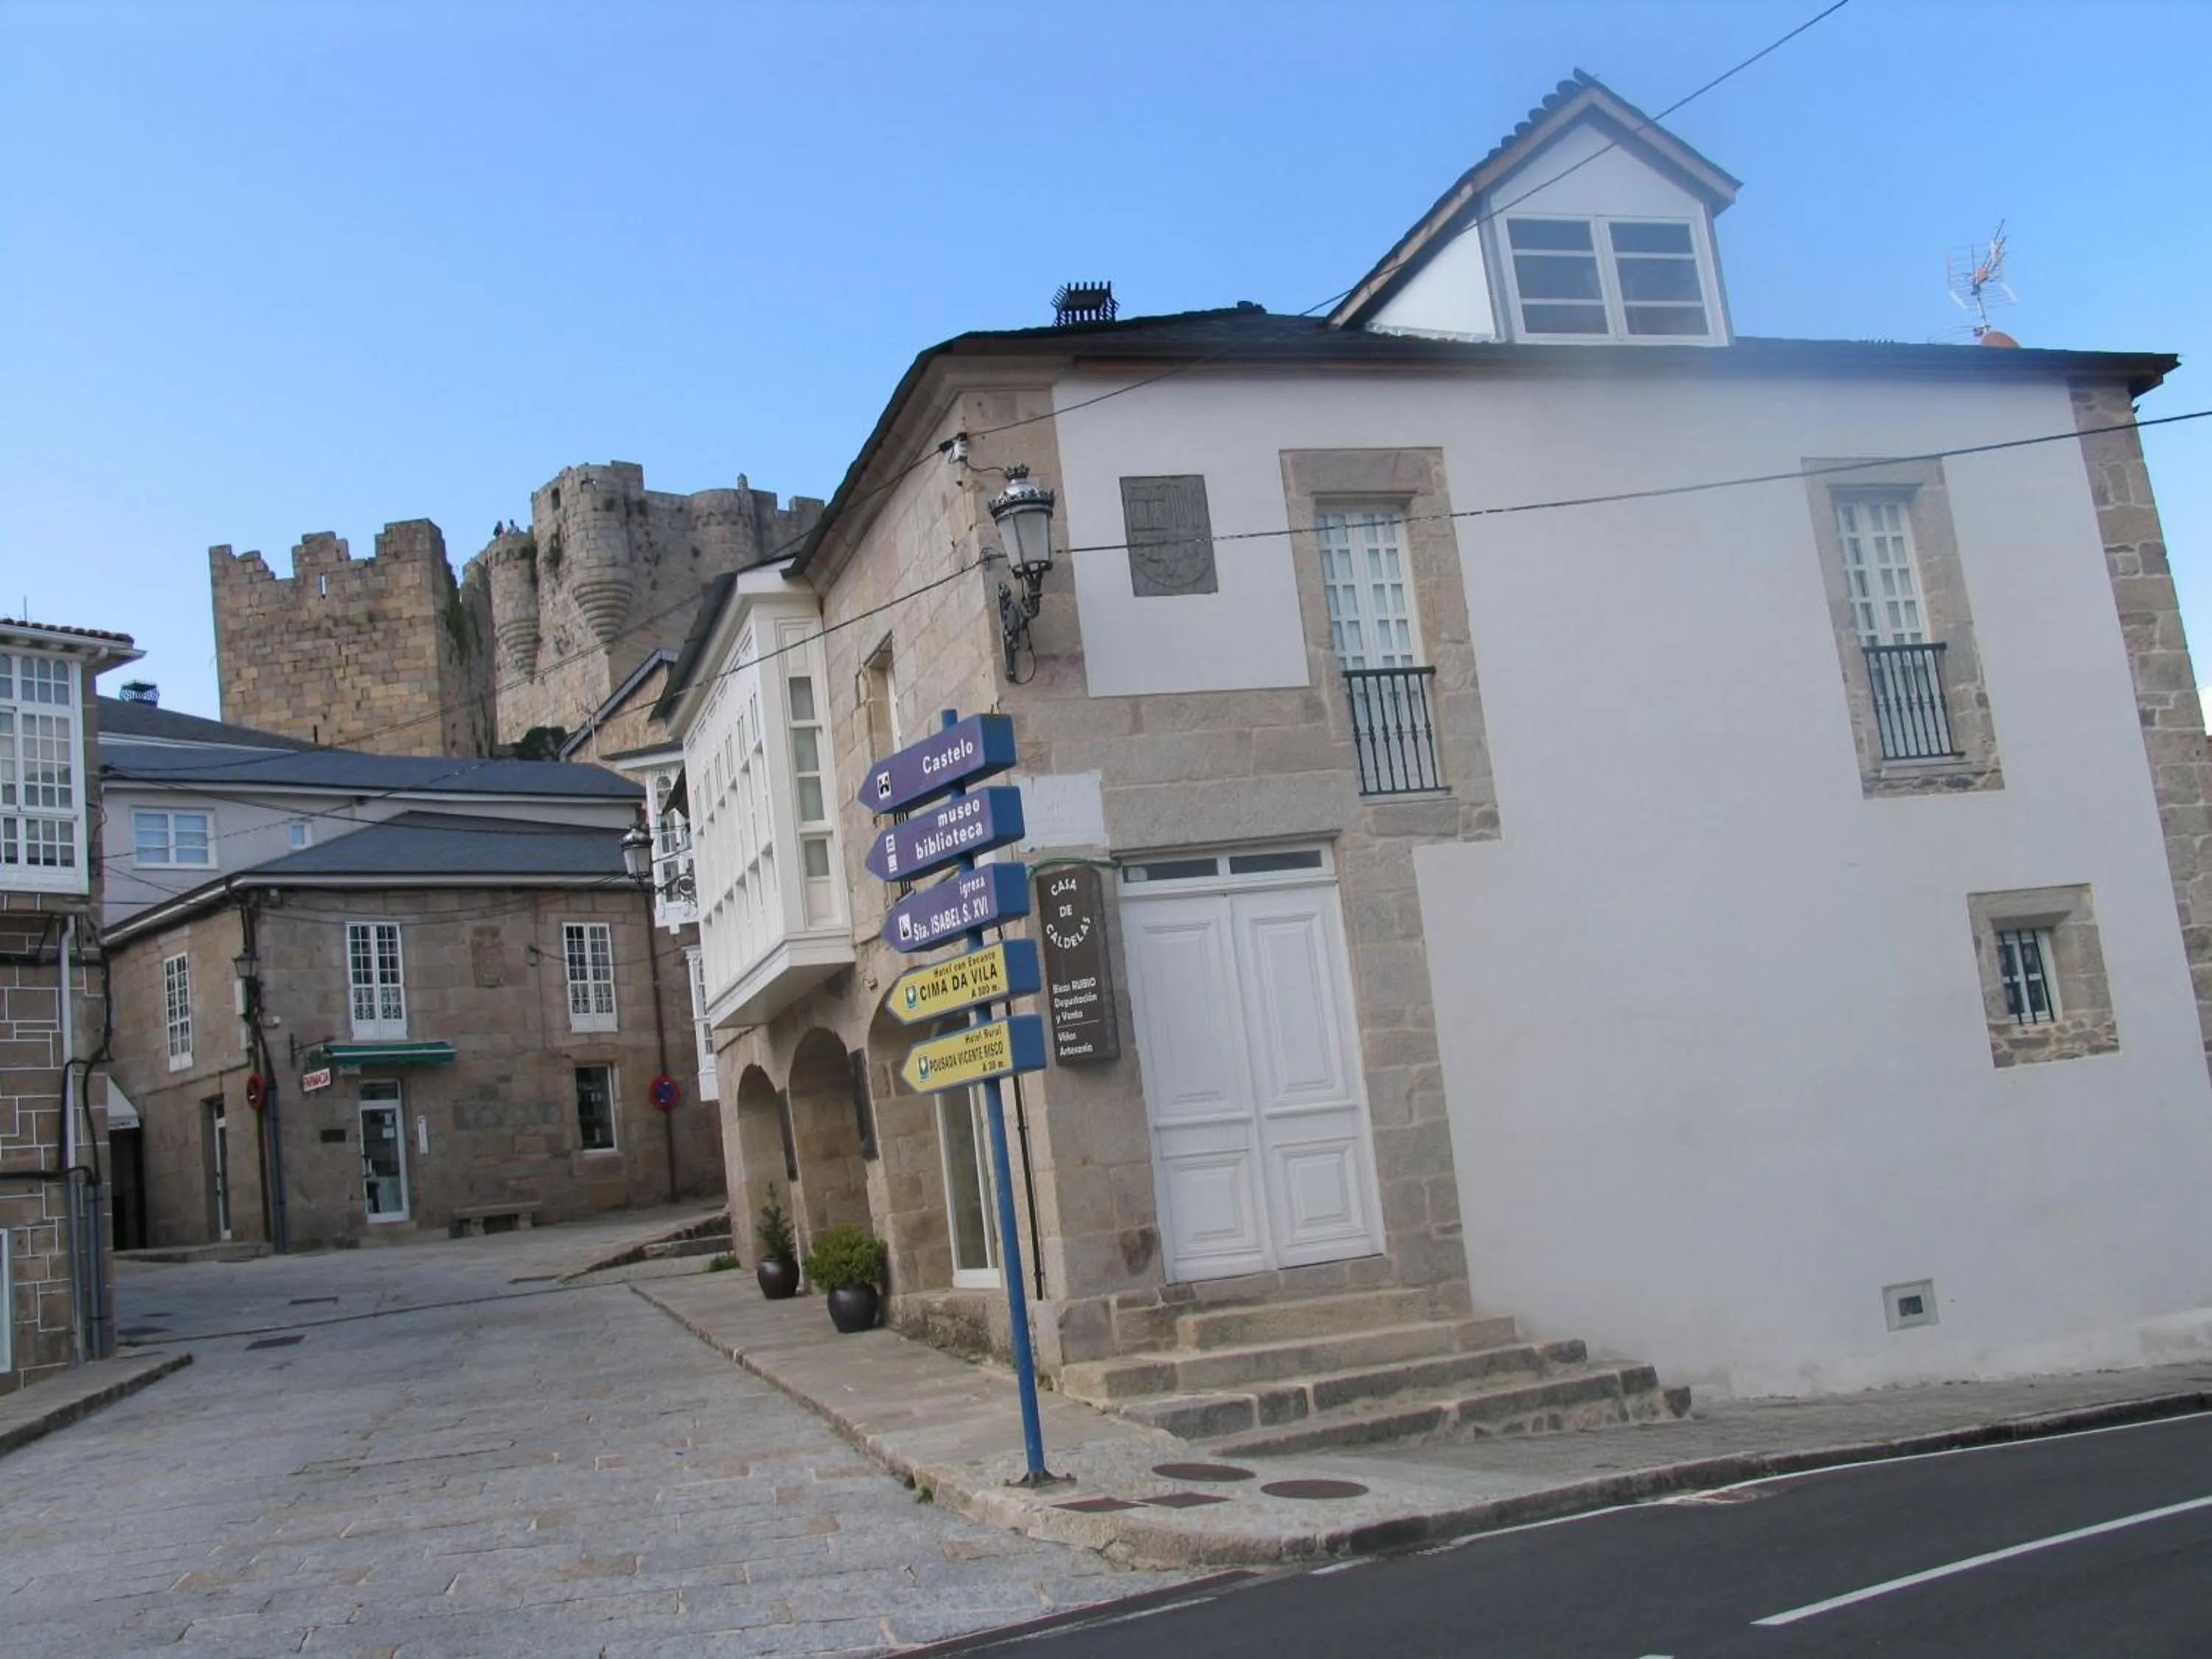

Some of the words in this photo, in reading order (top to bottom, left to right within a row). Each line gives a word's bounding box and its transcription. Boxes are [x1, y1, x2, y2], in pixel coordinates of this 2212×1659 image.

[922, 738, 973, 774] Castelo
[938, 799, 980, 827] museo
[915, 821, 983, 860] biblioteca
[959, 875, 986, 899] igrexa
[1051, 878, 1077, 896] CASA
[913, 922, 930, 942] Sta.
[931, 907, 961, 934] ISABEL
[962, 903, 972, 922] S.
[973, 896, 989, 918] XVI
[1059, 904, 1073, 918] DE
[1046, 917, 1091, 949] CALDELAS
[919, 978, 948, 1001] CIMA
[952, 973, 968, 991] DA
[971, 964, 998, 984] VILA
[1071, 977, 1096, 991] RUBIO
[1055, 1015, 1061, 1024] y
[1061, 1010, 1083, 1020] Venta
[930, 1054, 957, 1072] POUSADA
[958, 1046, 983, 1065] VICENTE
